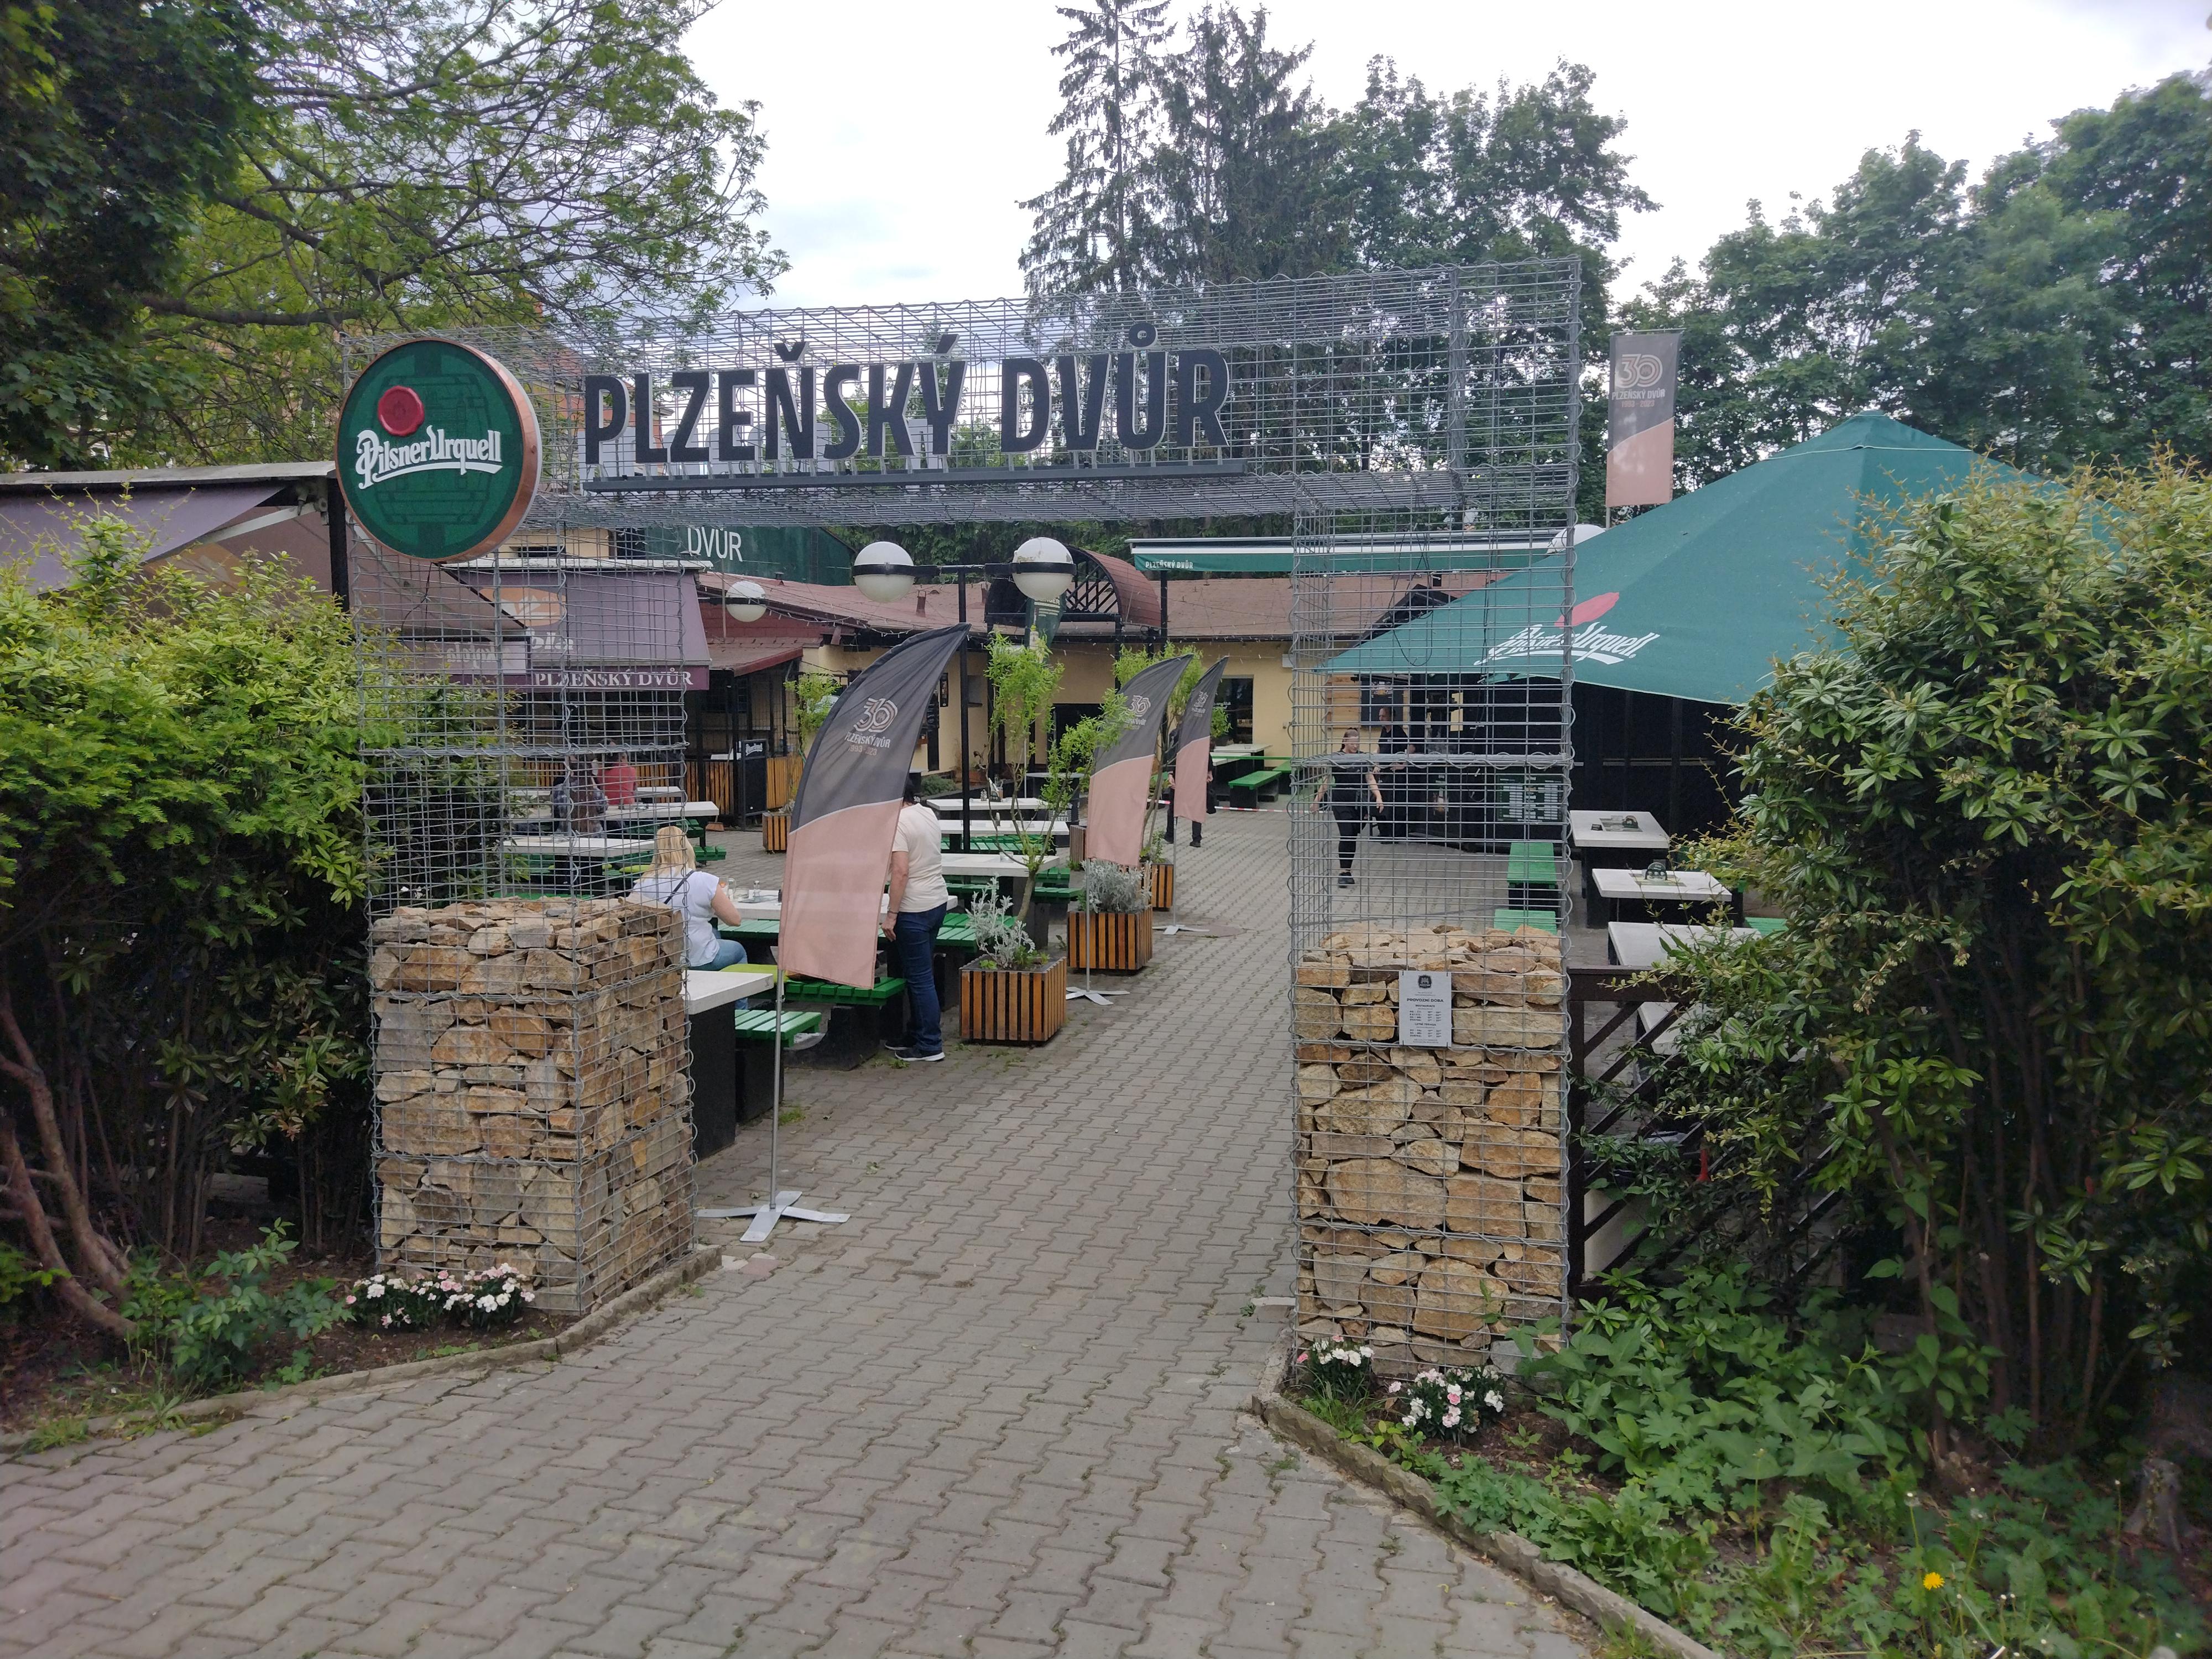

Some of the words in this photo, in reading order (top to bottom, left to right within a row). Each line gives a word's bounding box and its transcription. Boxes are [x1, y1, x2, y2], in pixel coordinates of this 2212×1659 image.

[586, 334, 967, 465] PLZEŇSKÝ
[1001, 322, 1230, 454] DVŮR
[1612, 389, 1646, 400] PLZEŇSKÝ
[1647, 388, 1665, 399] DVŮR
[356, 430, 430, 489] Pilsner
[426, 425, 502, 476] Urquell
[638, 667, 693, 686] DVŮR
